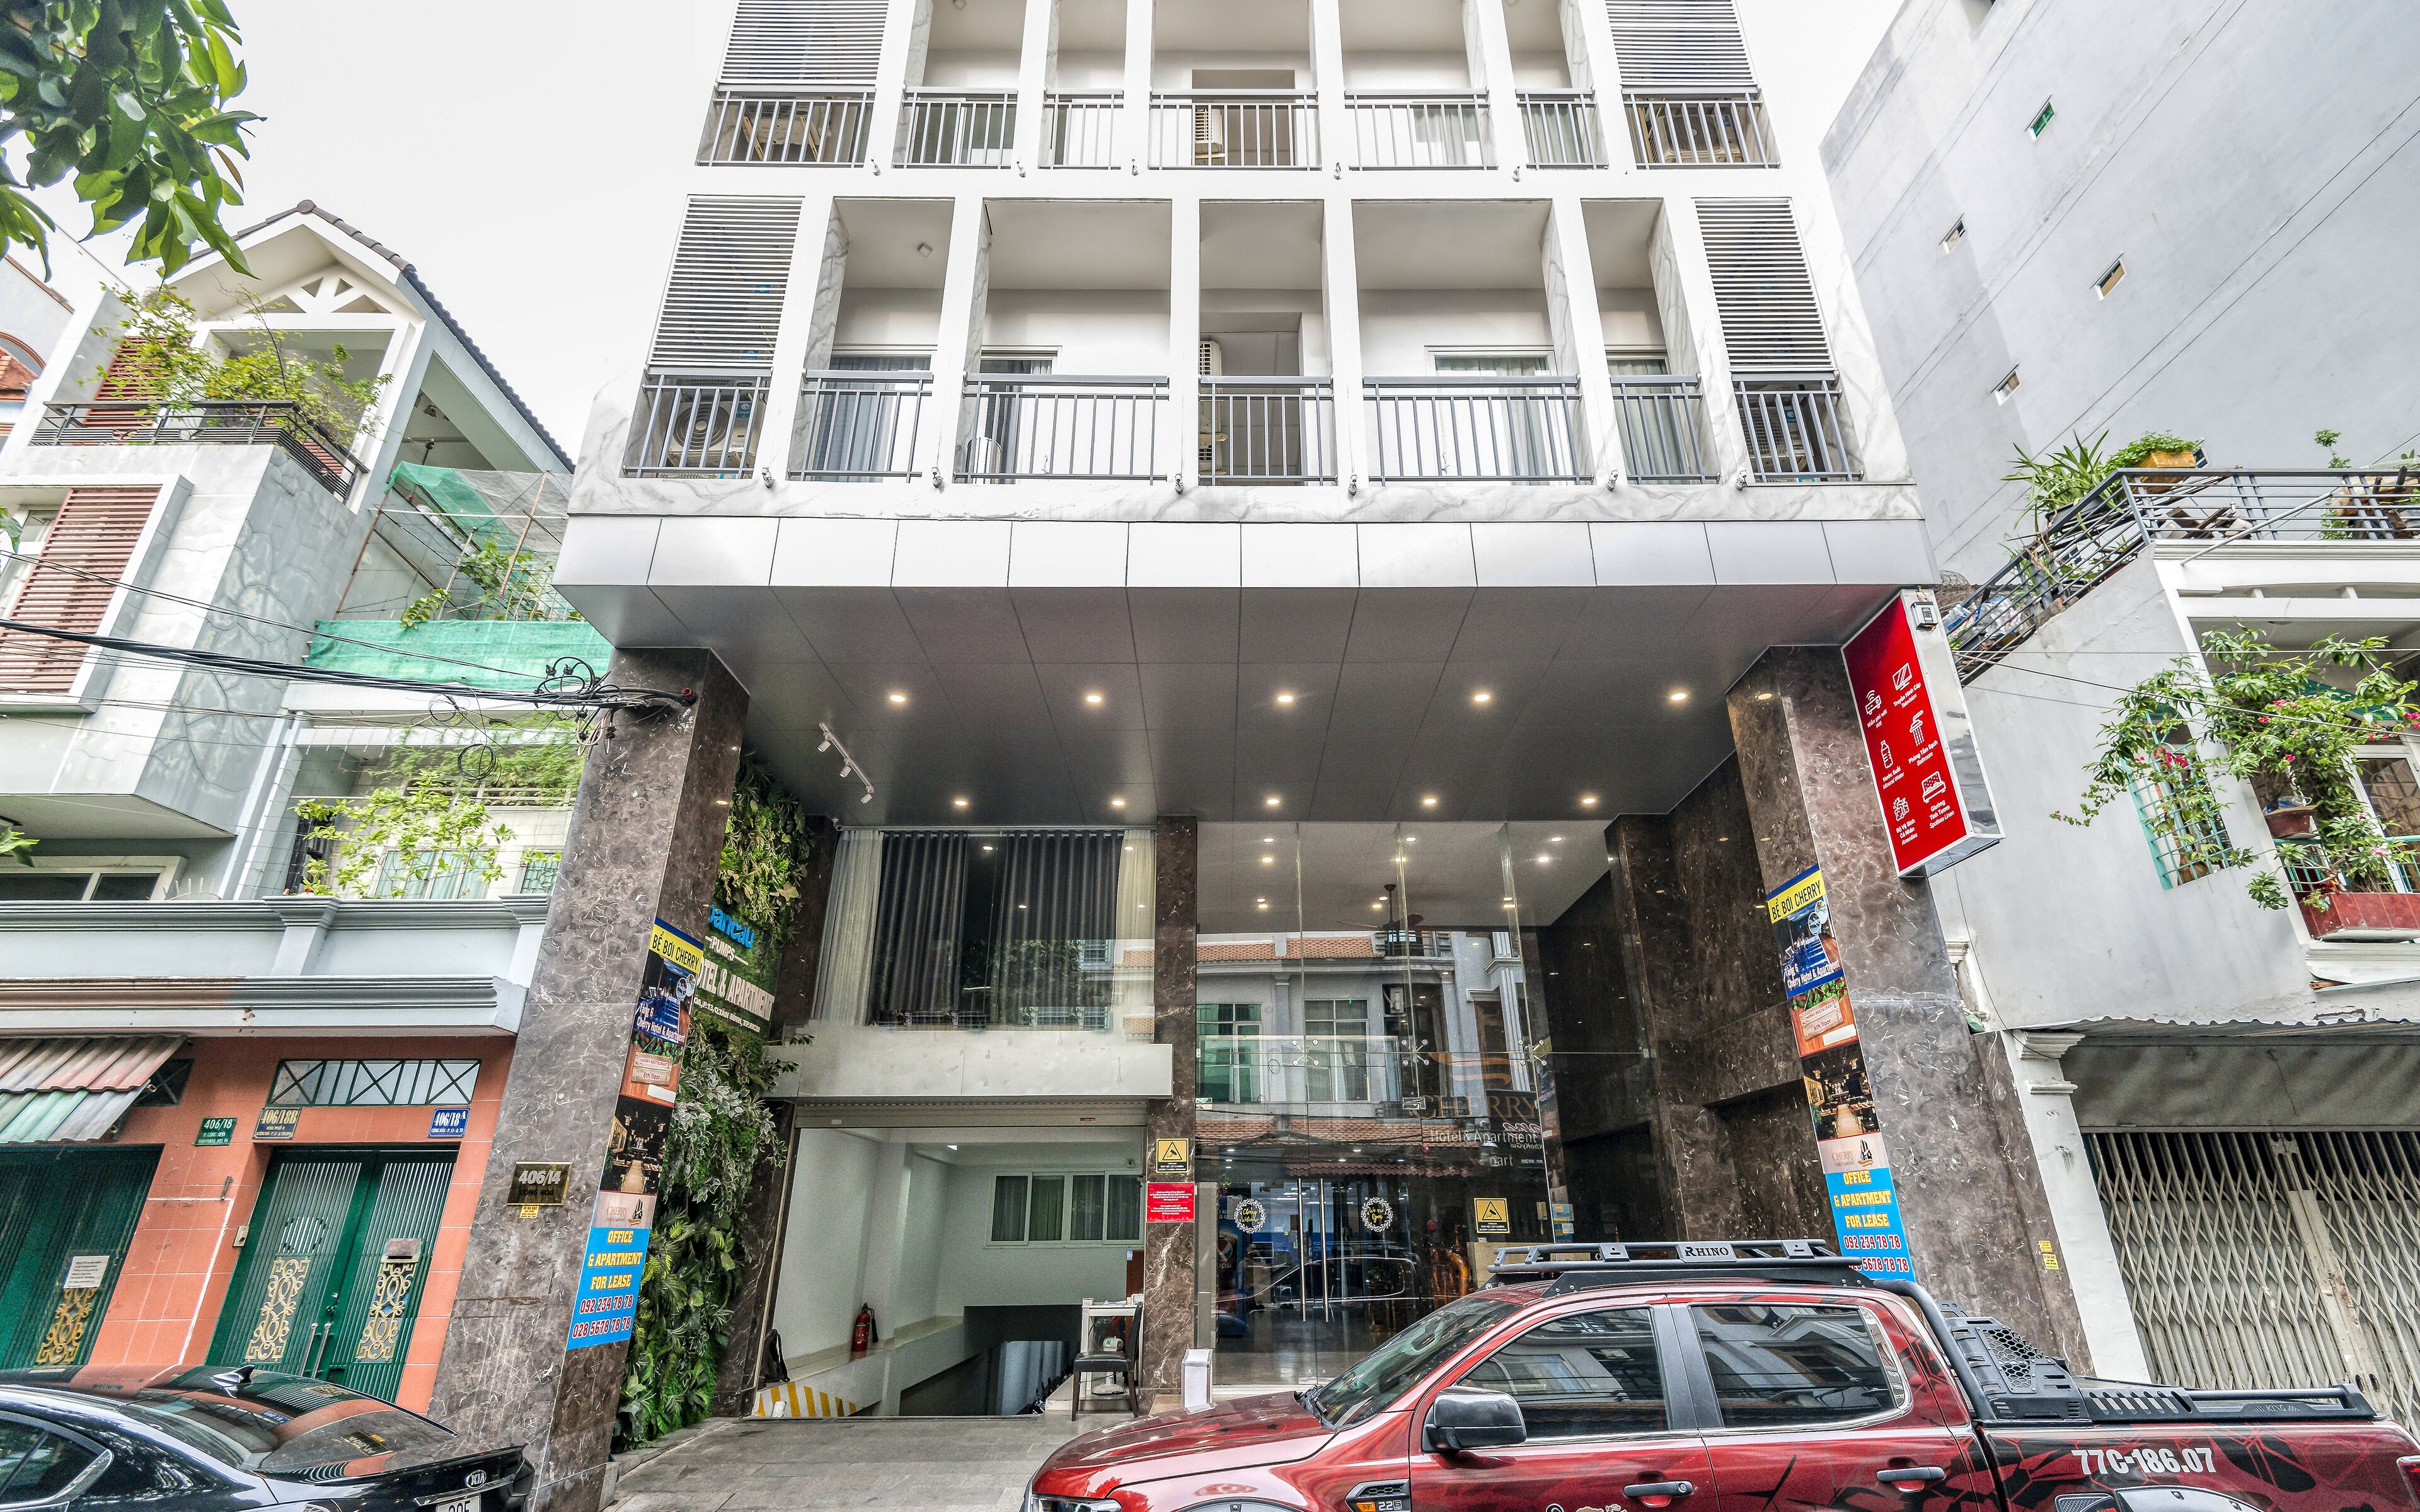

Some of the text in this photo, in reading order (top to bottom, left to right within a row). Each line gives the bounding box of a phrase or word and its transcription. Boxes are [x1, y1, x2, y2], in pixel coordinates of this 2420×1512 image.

[1772, 898, 1781, 920] BỂ
[1794, 880, 1821, 907] CHERRY
[652, 931, 664, 951] BỂ
[676, 947, 700, 970] CHERRY
[709, 936, 735, 961] PUMPS
[1787, 959, 1840, 990] Cherry Hotel & Apartment
[1794, 963, 1799, 973] 6
[696, 956, 775, 1021] OTEL & APARTMENT
[650, 1007, 654, 1017] 6
[1804, 1003, 1834, 1021] CHERRY RESTAURANT
[637, 1016, 686, 1043] Cherry Hotel & Apartment
[1821, 1019, 1831, 1029] floor
[204, 1119, 233, 1130] 406/18
[261, 1109, 299, 1125] 406/18B
[1430, 1130, 1461, 1143] Hotel
[519, 1169, 562, 1186] 406/14
[1843, 1170, 1871, 1185] OFFICE
[1834, 1190, 1892, 1208] & APARTMENT
[1243, 1208, 1258, 1218] Cherry
[1372, 1213, 1383, 1223] Open
[1845, 1213, 1890, 1228] FOR LEASE
[608, 1230, 633, 1244] OFFICE
[1844, 1234, 1901, 1249] 092 234 78 78
[588, 1252, 643, 1267] & APARTMENT
[1685, 1247, 1729, 1256] RHINO
[1862, 1257, 1883, 1271] 5678
[1884, 1257, 1897, 1272] 78
[1897, 1257, 1910, 1273] 78
[590, 1274, 631, 1290] FOR LEASE
[580, 1295, 633, 1314] 092 234 78 78
[572, 1316, 631, 1339] 028 5678 78 78
[2070, 1447, 2216, 1475] 77C-186.07
[471, 1473, 485, 1486] KIA
